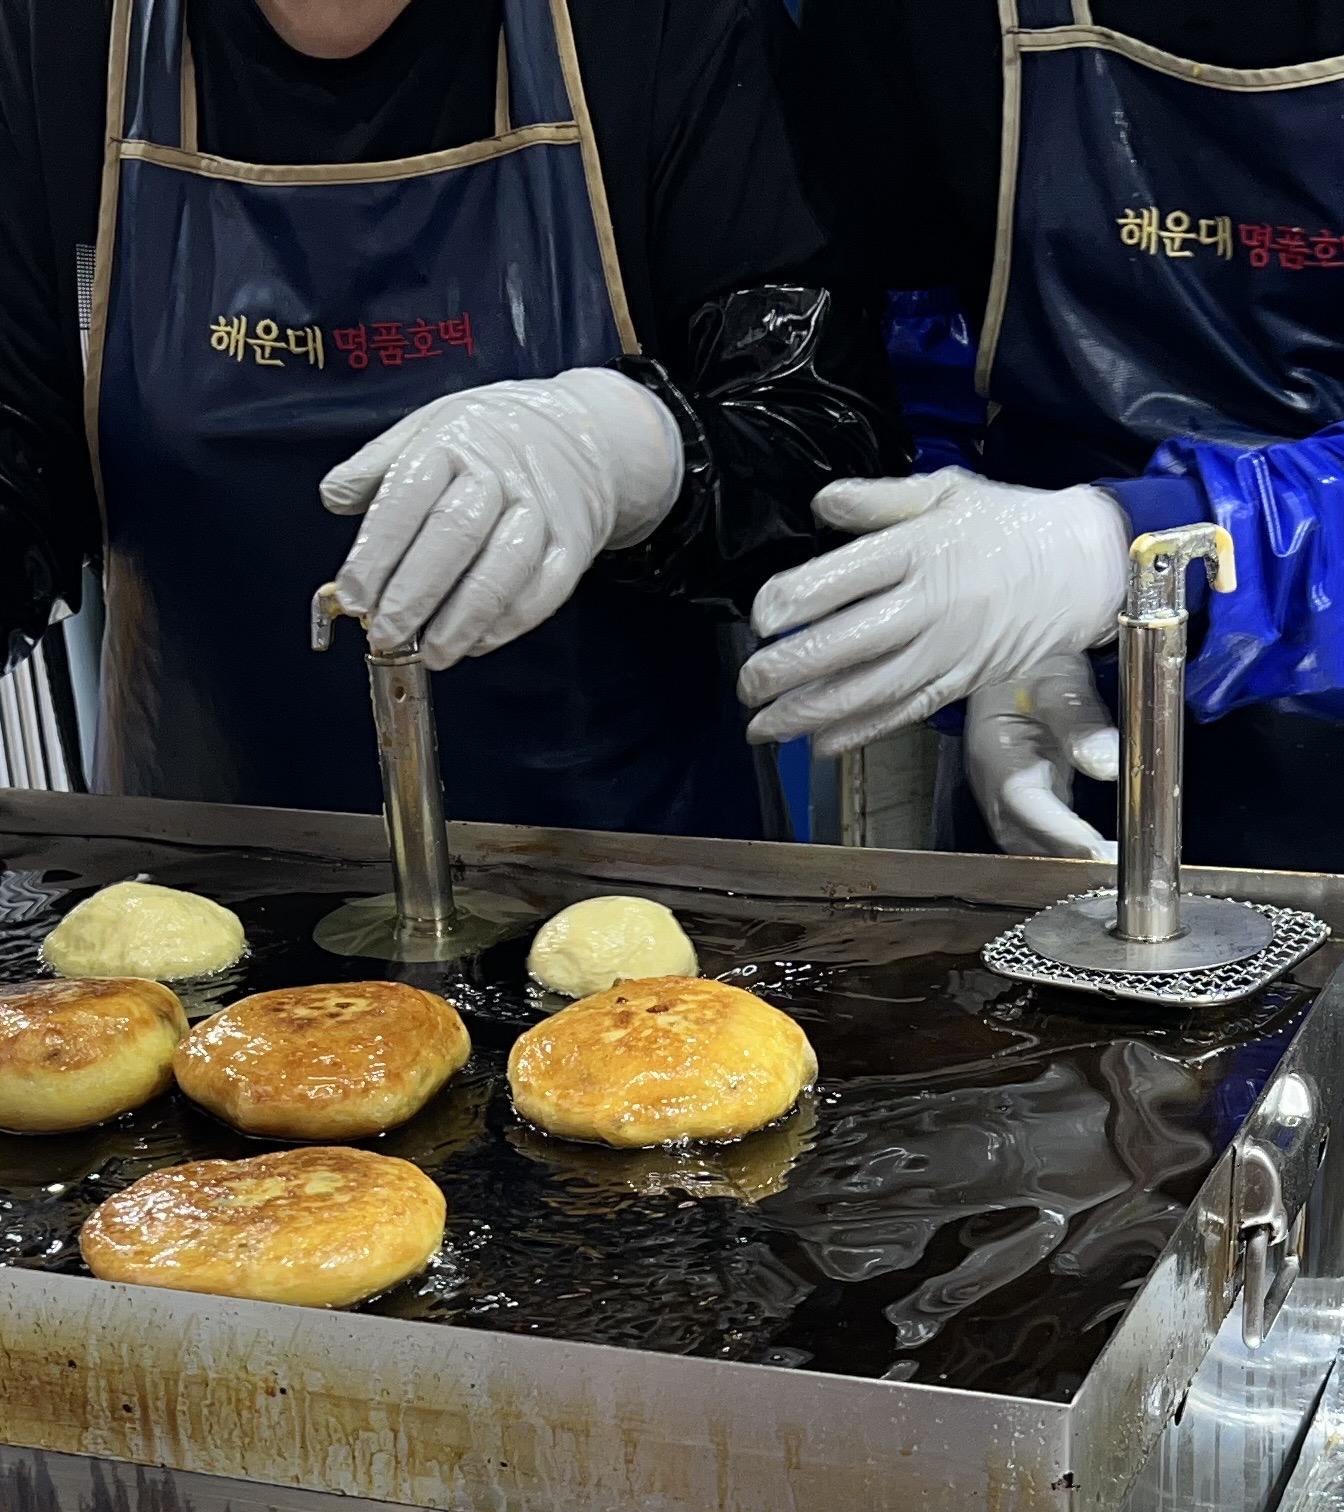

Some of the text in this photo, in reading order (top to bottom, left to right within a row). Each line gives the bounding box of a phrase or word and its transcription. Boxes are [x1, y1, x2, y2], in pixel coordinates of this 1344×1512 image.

[1115, 205, 1233, 261] 해운대
[210, 311, 475, 370] 해운대 명품호떡
